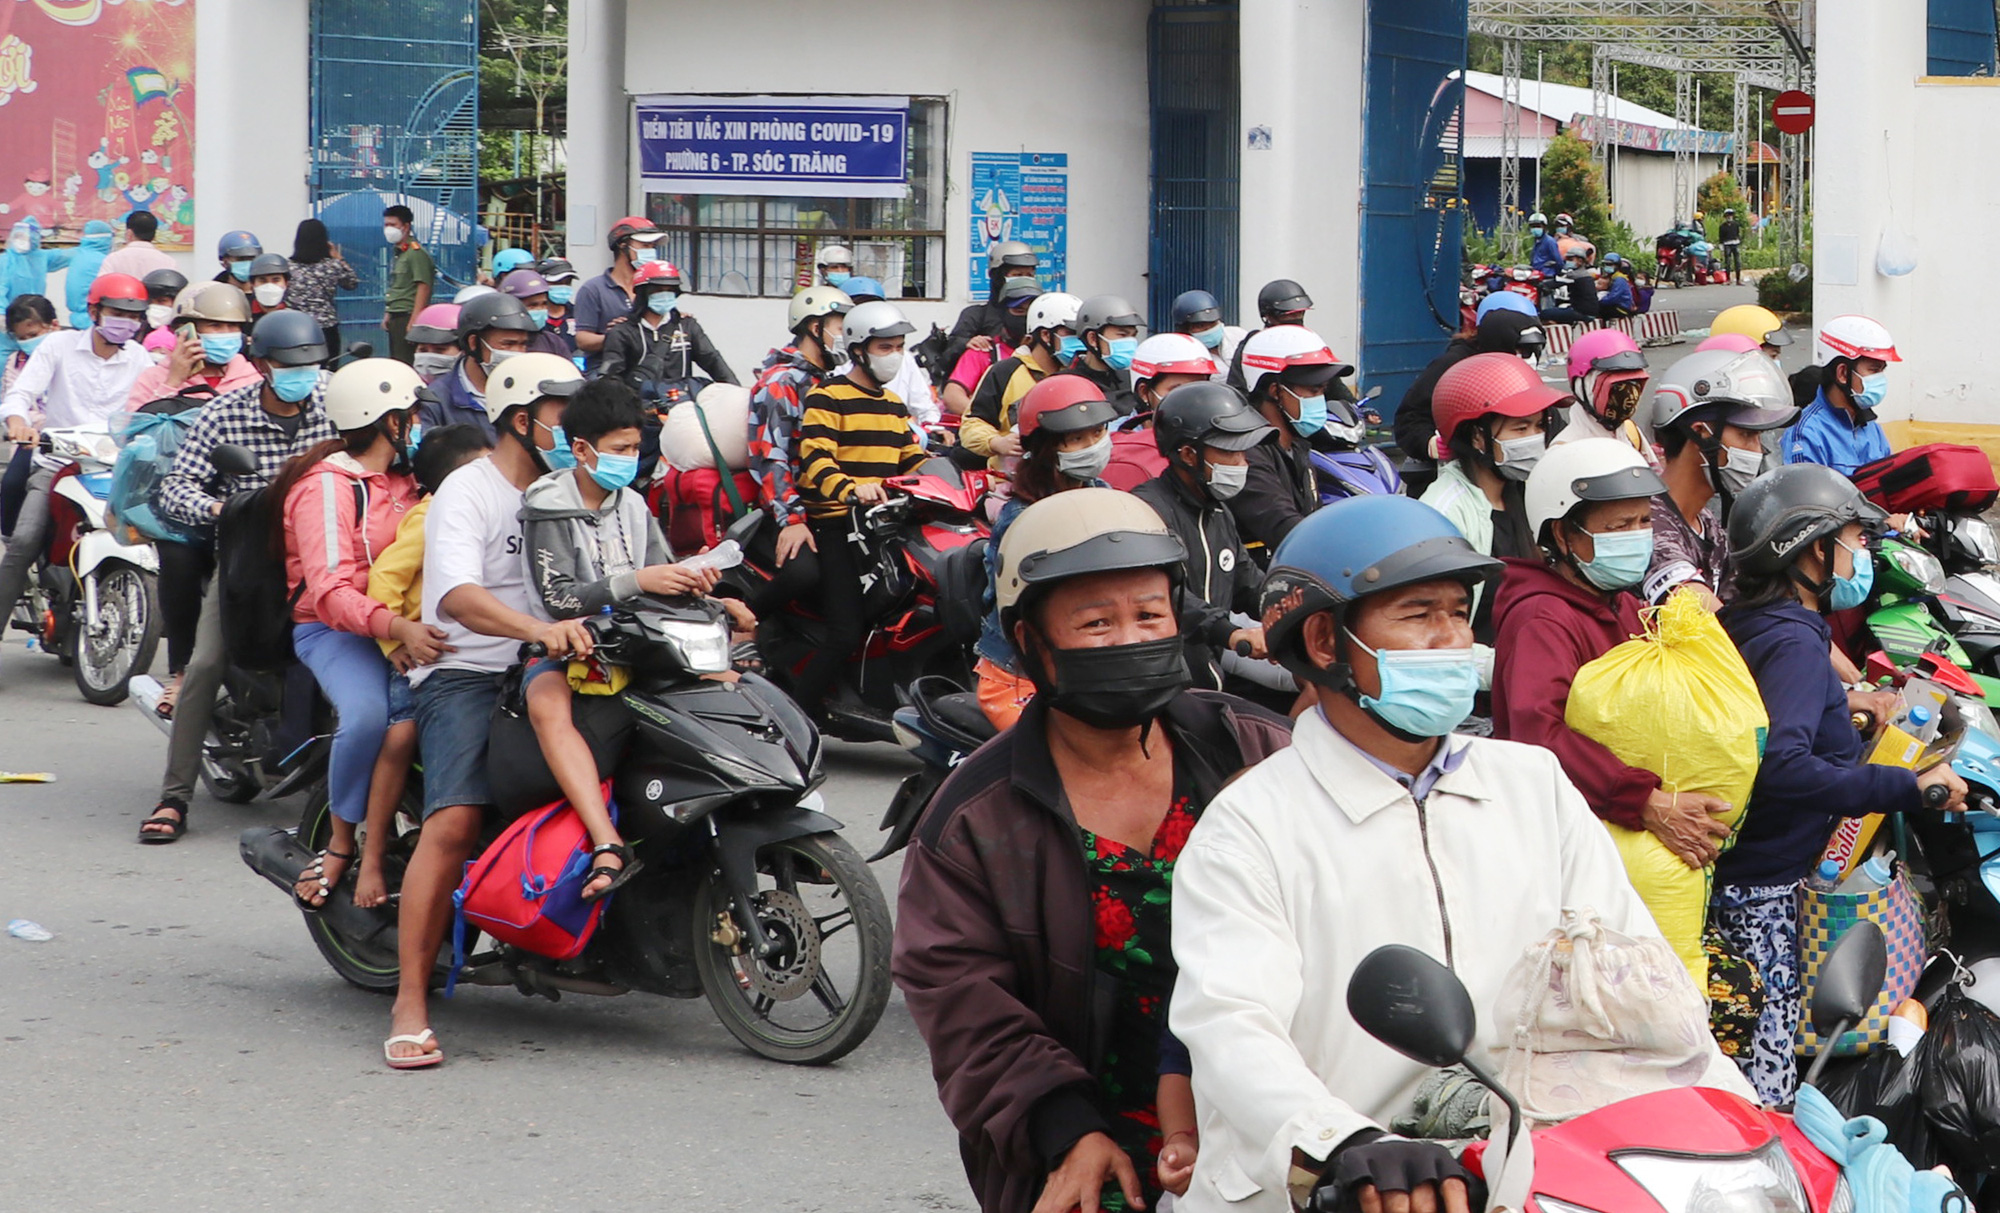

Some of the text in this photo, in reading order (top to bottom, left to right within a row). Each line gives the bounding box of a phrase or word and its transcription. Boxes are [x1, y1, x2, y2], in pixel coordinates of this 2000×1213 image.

[668, 117, 693, 140] TIÊM
[695, 114, 721, 140] VẮC
[724, 121, 748, 140] XIN
[750, 116, 806, 142] PHÒNG
[811, 122, 894, 143] COVID-19
[665, 147, 709, 171] PHƯỜNG
[711, 152, 720, 171] 6
[731, 152, 750, 172] TP.
[752, 149, 785, 172] SÓC
[789, 150, 847, 174] TRĂNG
